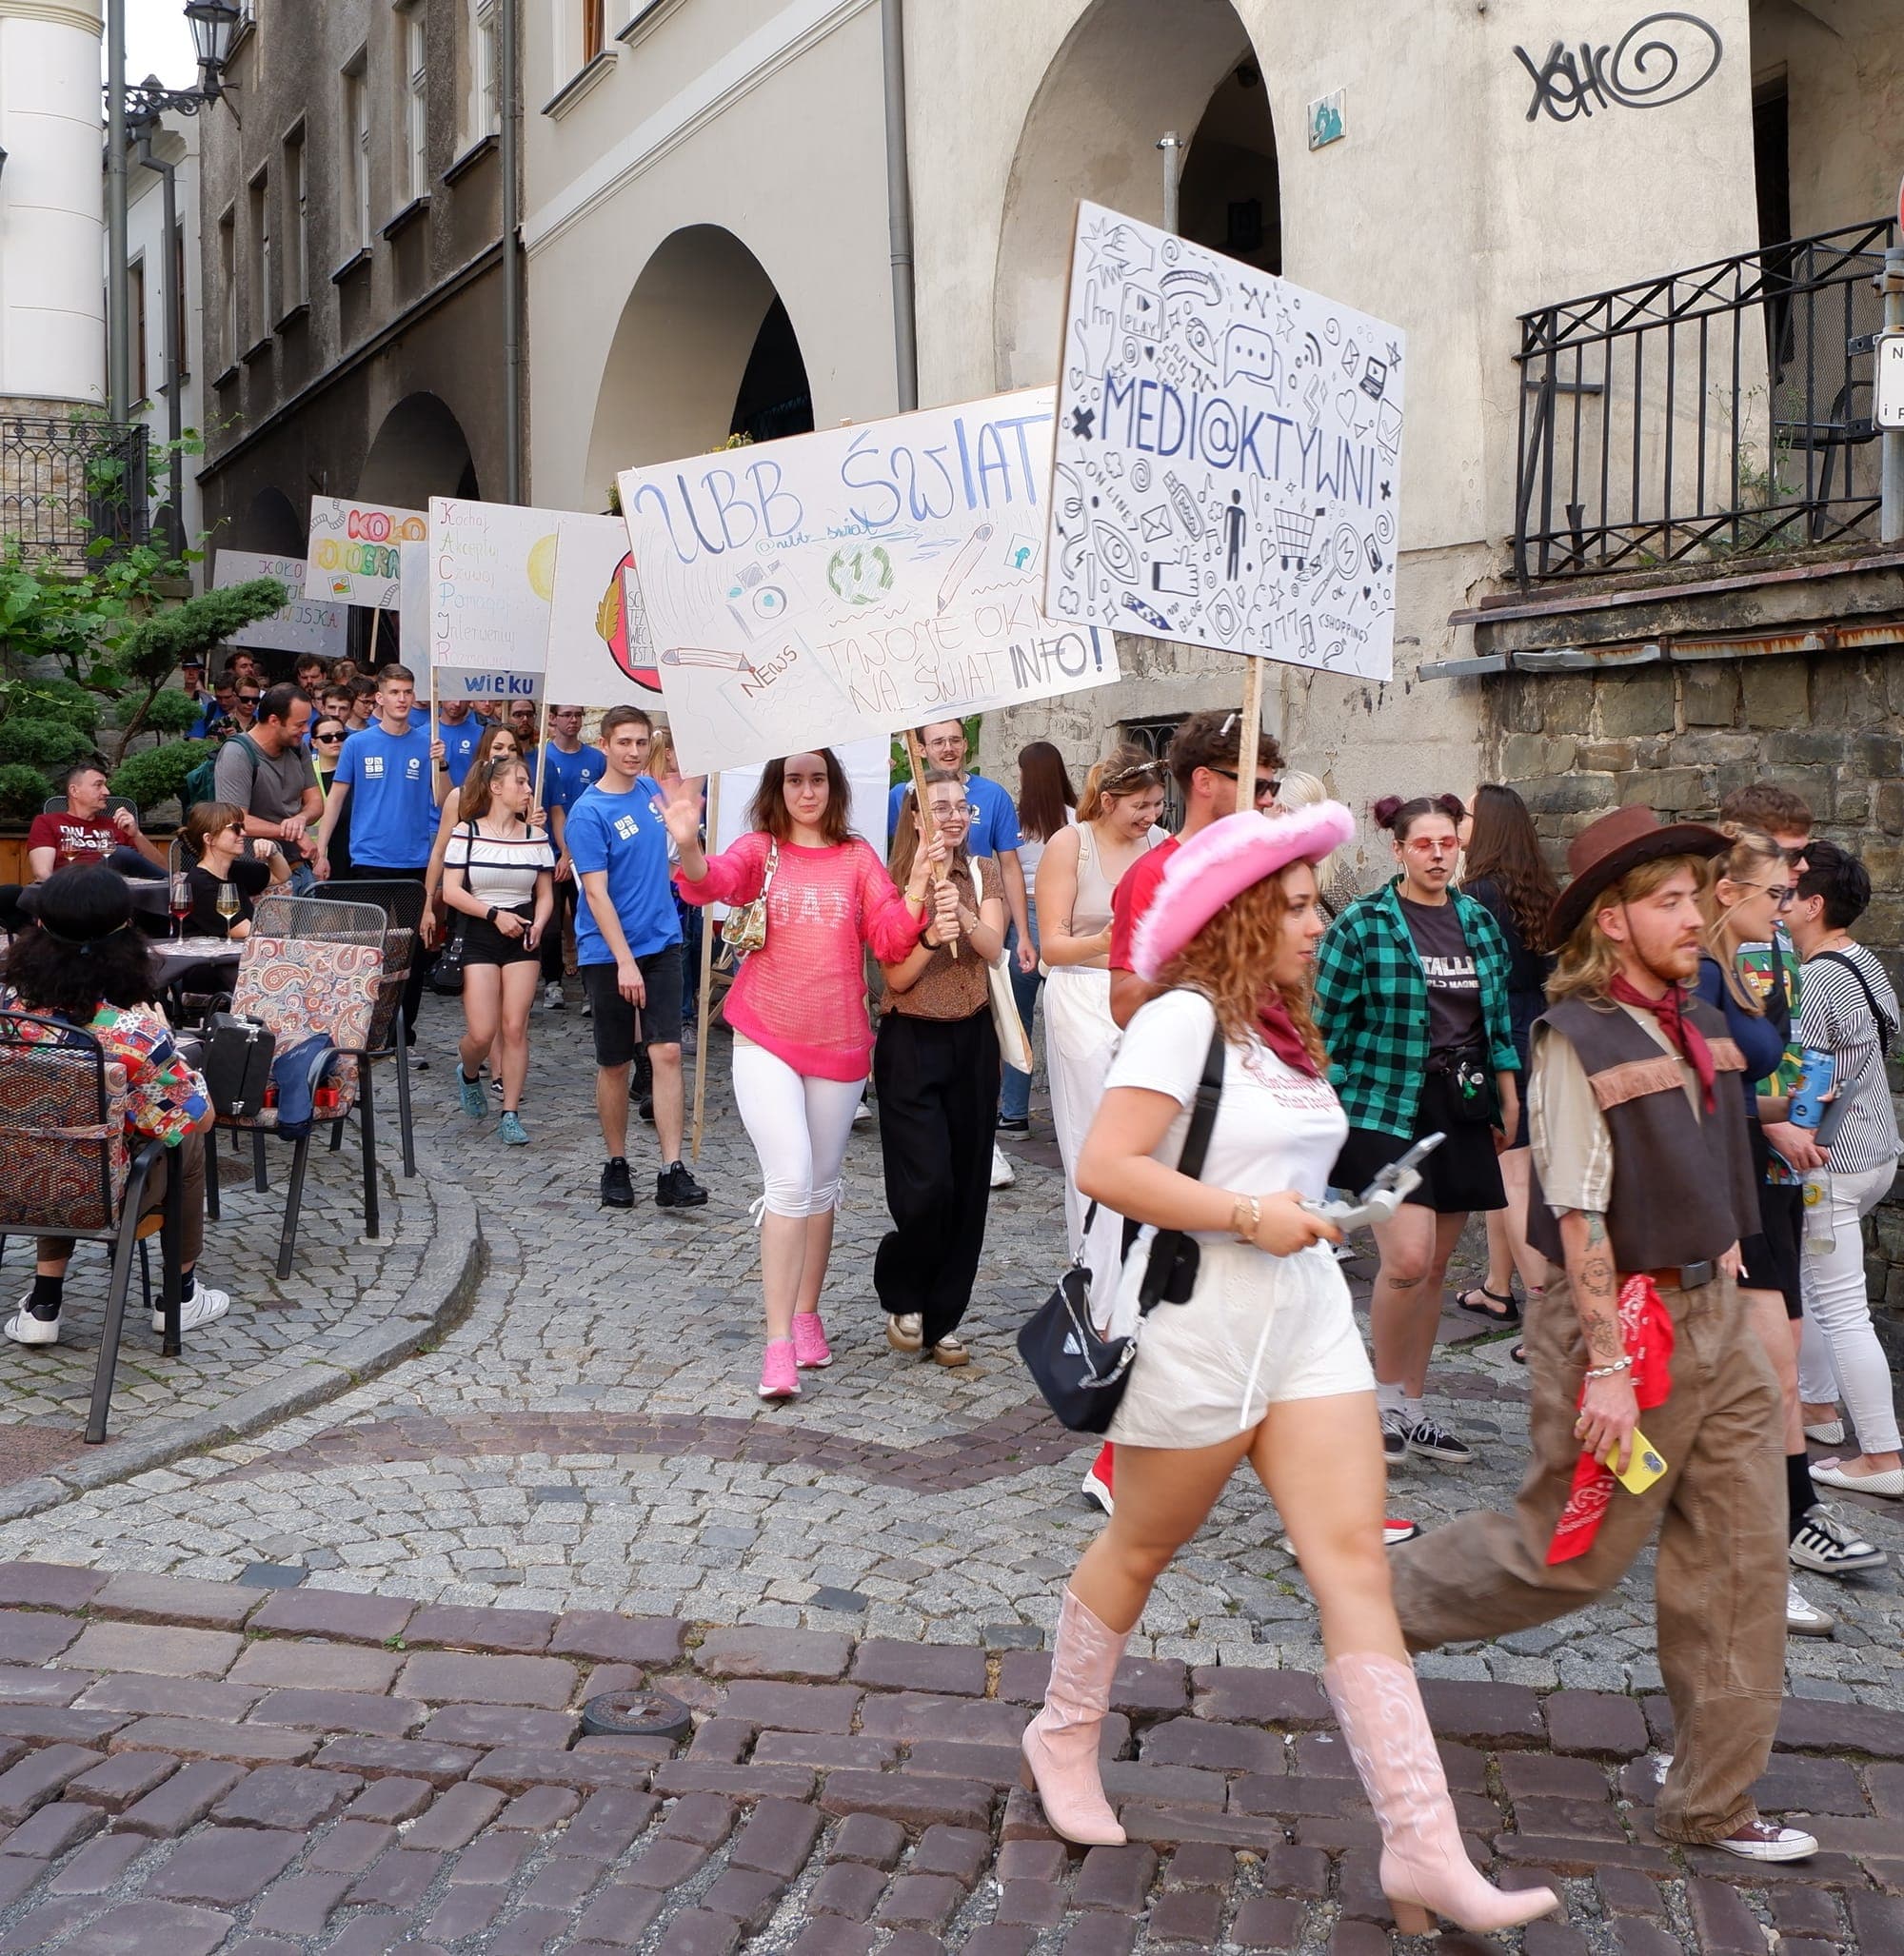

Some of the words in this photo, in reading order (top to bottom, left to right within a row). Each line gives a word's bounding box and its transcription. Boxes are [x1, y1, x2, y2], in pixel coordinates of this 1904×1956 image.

[1124, 314, 1157, 337] PLAY
[1101, 370, 1376, 509] MEDI@KTYWNI
[633, 460, 803, 564] UBB
[841, 412, 1054, 526] ŚWIAT
[439, 503, 490, 533] Kochaj
[258, 560, 303, 578] KOŁO
[312, 538, 399, 579] FOTOGRA
[974, 593, 1083, 638] OKN
[464, 673, 534, 695] wieku
[741, 644, 797, 698] NEWS
[846, 668, 900, 714] NA
